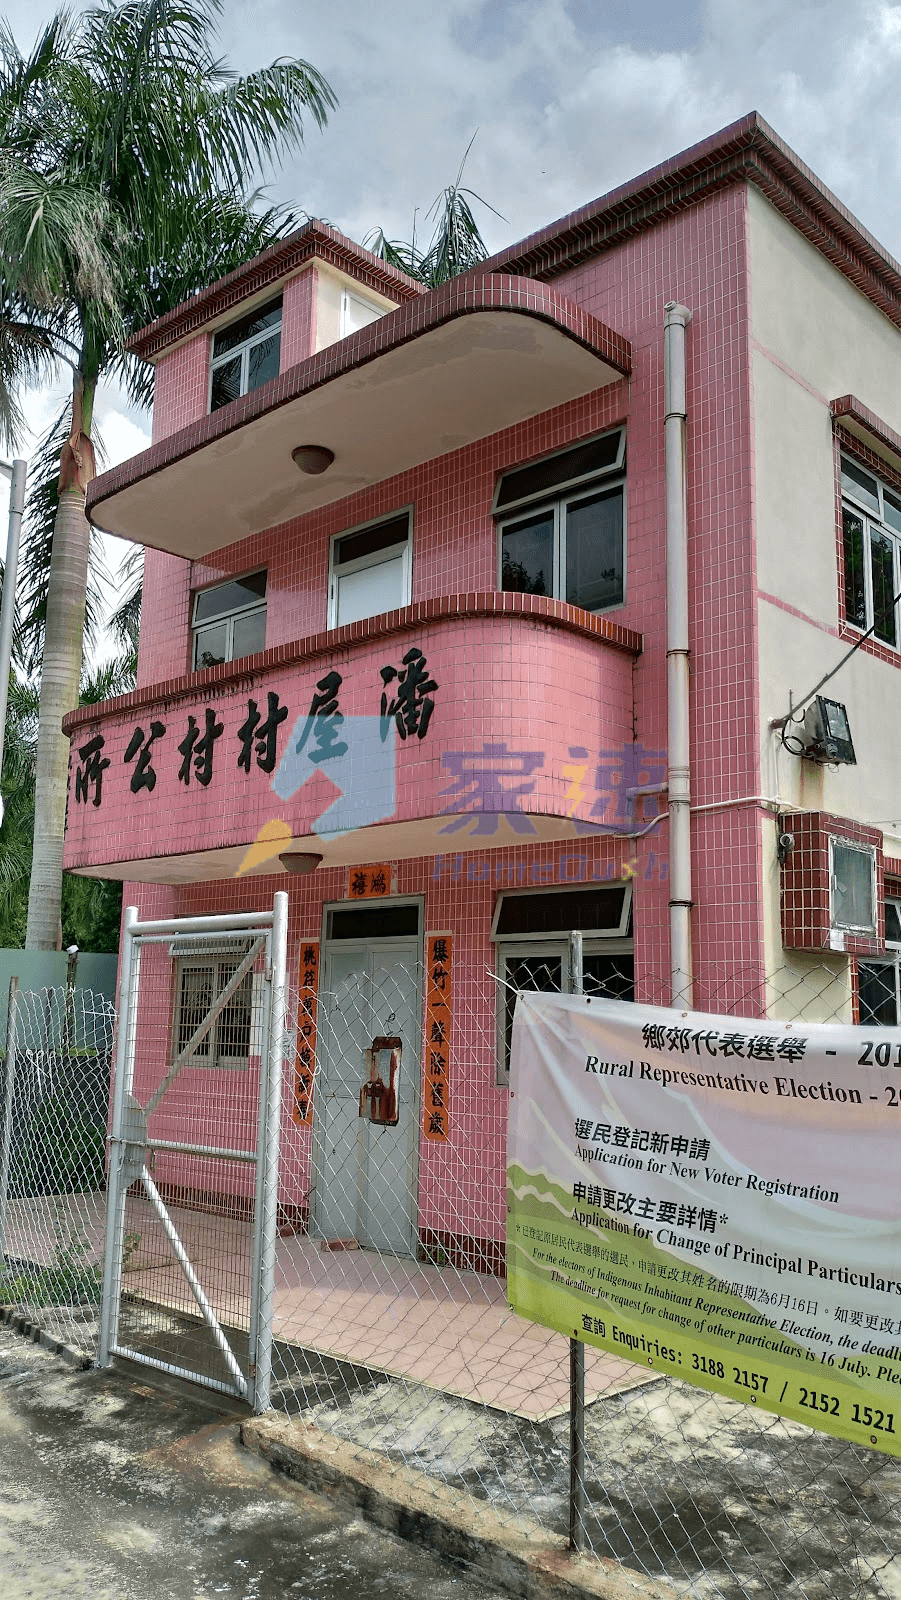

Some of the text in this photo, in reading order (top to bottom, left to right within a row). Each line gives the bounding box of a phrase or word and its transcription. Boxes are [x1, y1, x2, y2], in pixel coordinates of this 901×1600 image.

[641, 1023, 809, 1064] 鄉郊代表選舉
[584, 1055, 635, 1078] Rural
[639, 1060, 770, 1095] Representative
[773, 1076, 864, 1105] Election
[884, 1086, 901, 1107] 2
[574, 1118, 711, 1162] 選民登記新申請
[574, 1144, 840, 1204] Application for New Voter Registration
[570, 1207, 901, 1296] Application for Change of Principal Particulars
[532, 1247, 545, 1259] For
[546, 1252, 557, 1265] the
[558, 1256, 586, 1274] electors
[587, 1266, 596, 1279] of
[596, 1267, 642, 1293] Indigenous
[643, 1282, 693, 1308] Inhabitant
[694, 1296, 778, 1329] Representative
[779, 1318, 834, 1347] Election,
[837, 1334, 859, 1351] the
[550, 1269, 901, 1386] The deadline for request for change of other particulars is 16 July. Ple
[581, 1313, 606, 1338] 查詢
[612, 1324, 683, 1365] Enquiries:
[691, 1353, 726, 1379] 3188
[732, 1367, 769, 1394] 2157
[798, 1387, 841, 1417] 2152
[851, 1403, 896, 1435] 1521
